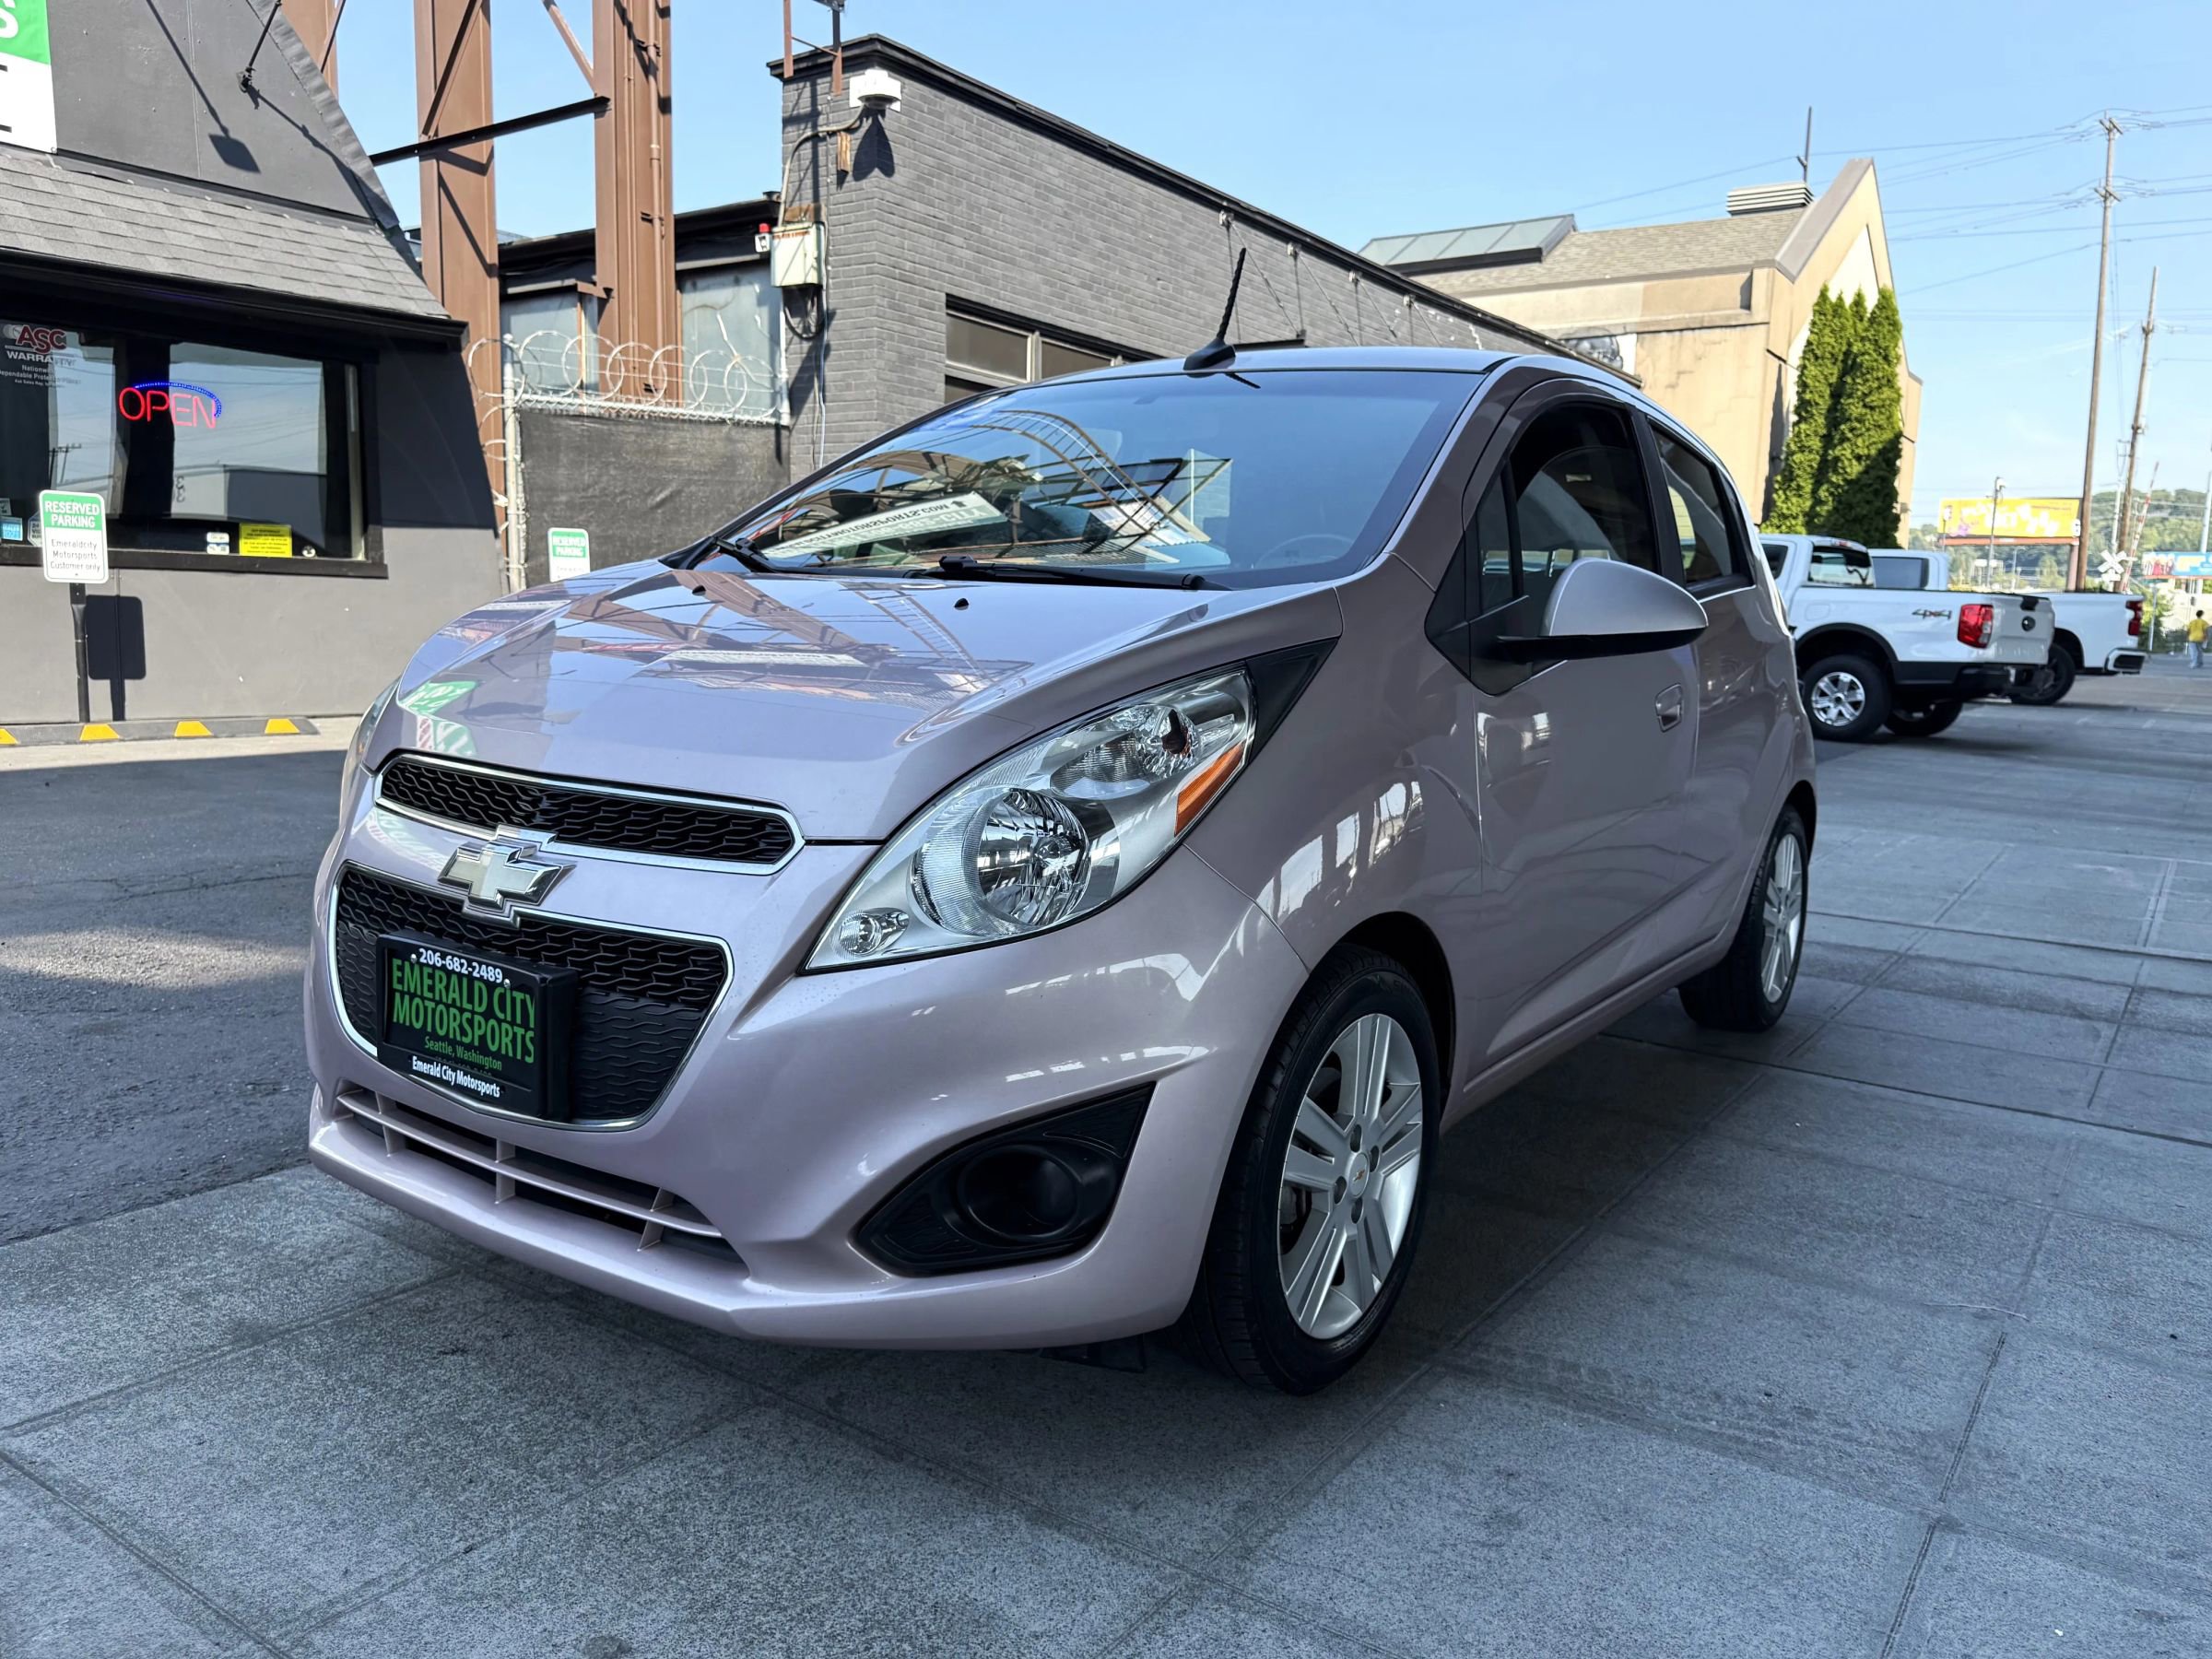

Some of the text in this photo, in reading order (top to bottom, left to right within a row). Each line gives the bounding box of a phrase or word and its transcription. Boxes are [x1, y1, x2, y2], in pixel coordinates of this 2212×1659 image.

[16, 324, 67, 355] ASC
[0, 370, 32, 379] ependable
[118, 387, 217, 429] OPEN
[44, 500, 100, 516] RESERVED
[51, 514, 96, 529] PARKING
[50, 560, 84, 570] Customer
[53, 549, 98, 560] Motorsports
[418, 947, 503, 983] 206-682-2489
[392, 958, 535, 1029] EMERALD CITY
[392, 992, 535, 1064] MOTORSPORTS
[424, 1035, 455, 1059] Seattle,
[456, 1044, 502, 1072] Washington
[412, 1055, 441, 1078] Emerald
[441, 1065, 456, 1086] City
[456, 1069, 501, 1099] Motorsports
